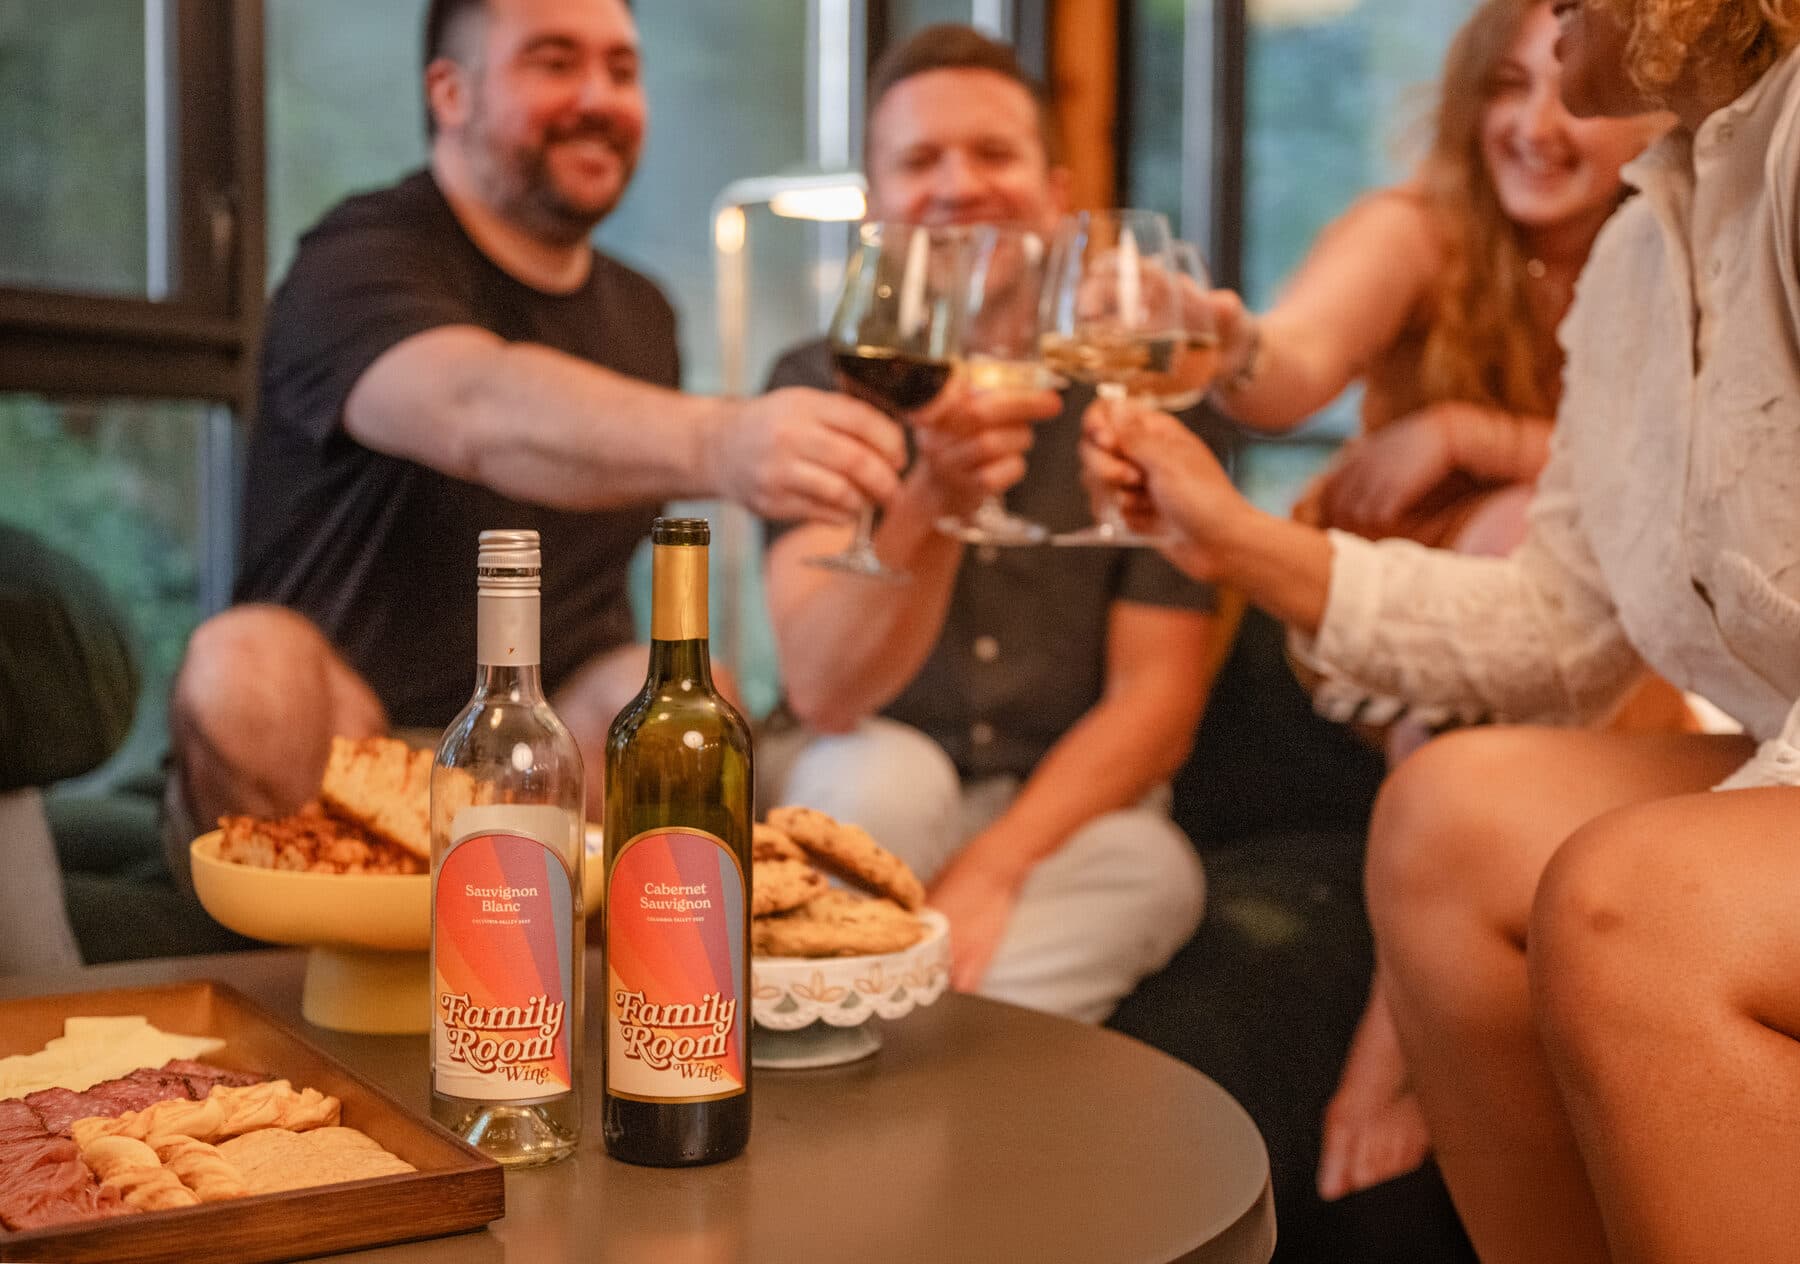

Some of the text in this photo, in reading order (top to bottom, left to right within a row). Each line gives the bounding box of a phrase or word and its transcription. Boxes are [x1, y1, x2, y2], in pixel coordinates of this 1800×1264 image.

[465, 884, 538, 900] Sauvignon
[644, 883, 706, 895] Cabernet
[482, 900, 521, 912] Blanc
[640, 897, 711, 913] Sauvignon
[440, 992, 565, 1039] Family
[615, 989, 736, 1036] Family
[447, 1027, 555, 1074] Room
[620, 1024, 728, 1071] Room
[498, 1065, 549, 1085] Wine
[673, 1062, 723, 1082] Wine
